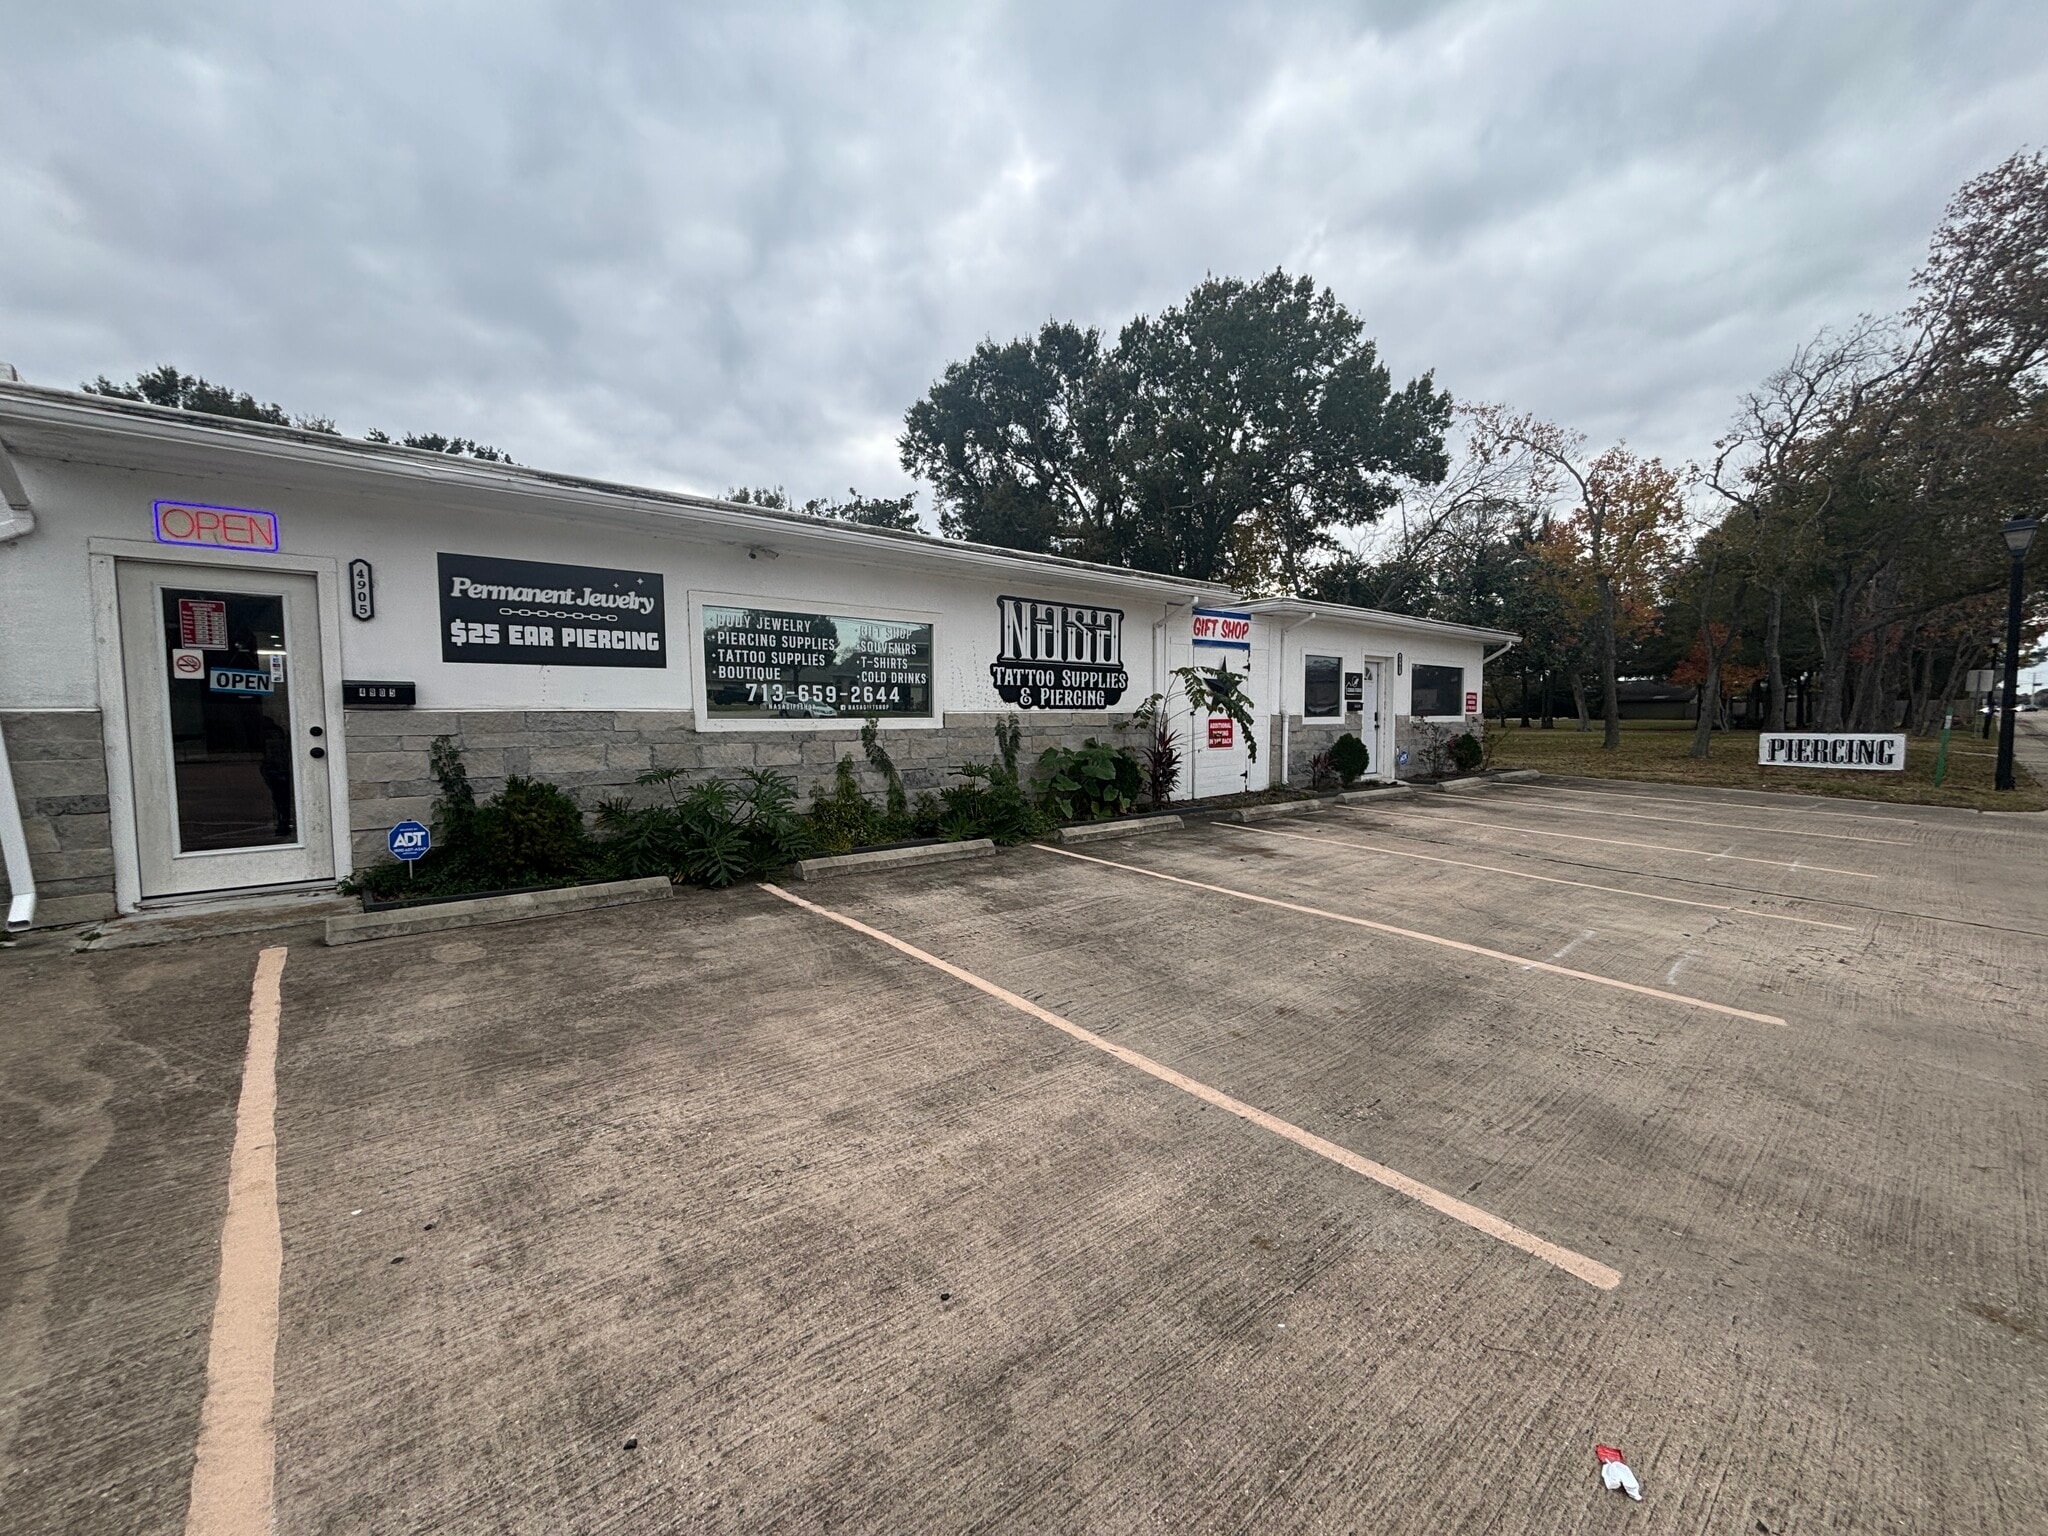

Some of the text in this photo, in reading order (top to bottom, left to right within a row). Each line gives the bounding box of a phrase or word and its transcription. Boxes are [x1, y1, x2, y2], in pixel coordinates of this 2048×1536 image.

[162, 508, 272, 545] OPEN
[356, 569, 368, 615] 4905
[450, 576, 654, 615] Permanent Jewelry
[717, 614, 811, 633] BODY JEWELRY
[1193, 617, 1250, 640] GIFT SHOP
[450, 618, 660, 651] $25 EAR PIERCING
[717, 631, 835, 651] PIERCING SUPPLIES
[885, 627, 912, 640] SHOP
[860, 640, 917, 655] SOUVENIRS
[717, 649, 826, 667] TATTOO SUPPLIES
[861, 656, 908, 669] T-SHIRTS
[216, 672, 269, 691] OPEN
[718, 665, 781, 681] BOUTIQUE
[861, 671, 927, 684] COLD DRINKS
[993, 666, 1127, 689] TATTOO SUPPLIES
[359, 687, 396, 697] 4905
[745, 683, 900, 703] 713-659-2644
[1020, 687, 1105, 706] & PIERCING
[1767, 738, 1896, 765] PIERCING
[393, 831, 426, 847] ADT
